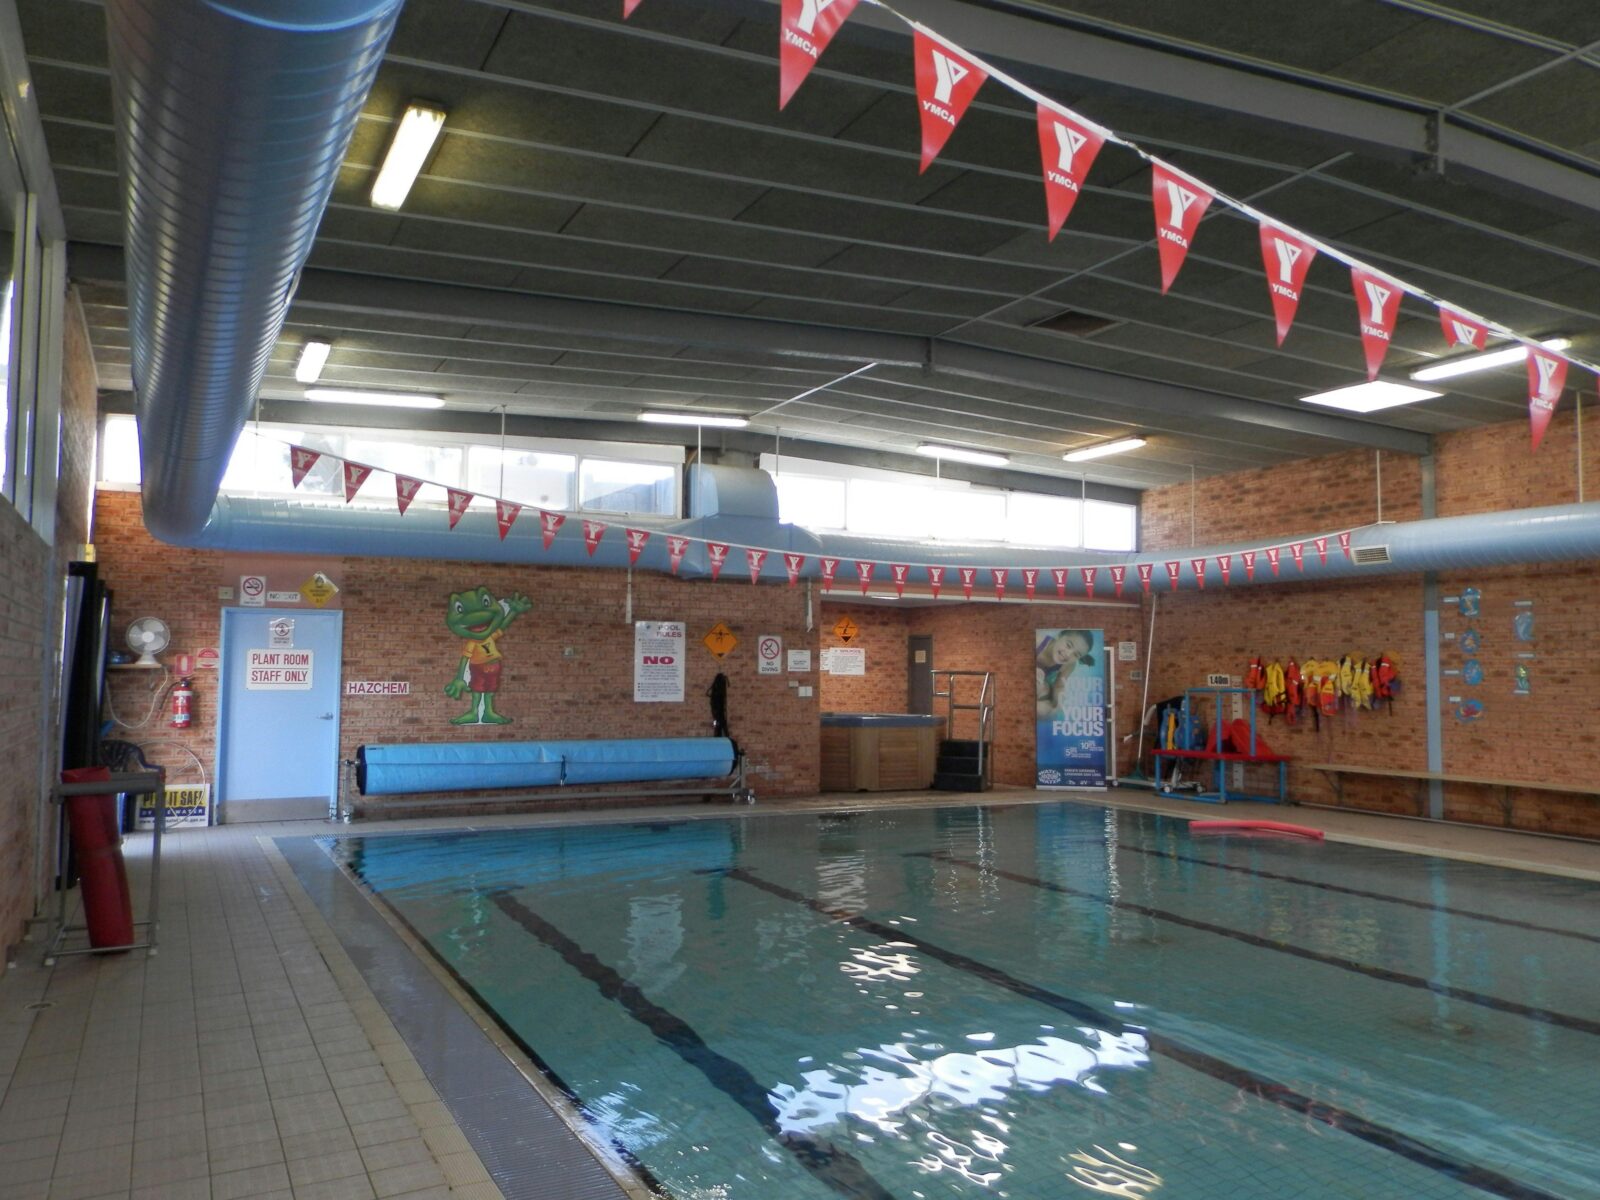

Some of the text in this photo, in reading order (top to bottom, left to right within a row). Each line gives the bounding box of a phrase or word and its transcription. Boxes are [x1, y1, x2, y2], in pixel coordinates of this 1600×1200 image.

[784, 29, 818, 59] YMCA
[932, 49, 969, 103] Y
[922, 100, 956, 125] YMCA
[1054, 121, 1087, 173] Y
[1047, 171, 1078, 193] YMCA
[1167, 180, 1197, 229] Y
[1160, 227, 1188, 248] YMCA
[1274, 237, 1302, 284] Y
[1272, 283, 1298, 302] YMCA
[1364, 280, 1391, 324] Y
[1361, 324, 1390, 341] YMCA
[1534, 354, 1558, 395] Y
[1530, 396, 1553, 411] YMCA
[297, 451, 312, 468] Y
[350, 466, 364, 483] Y
[401, 479, 414, 497] Y
[453, 493, 466, 510] Y
[501, 504, 514, 521] Y
[545, 514, 558, 530] Y
[588, 523, 601, 539] Y
[631, 531, 644, 547] Y
[672, 539, 684, 554] Y
[712, 545, 724, 560] Y
[751, 551, 762, 565] Y
[1245, 553, 1253, 565] Y
[1269, 549, 1277, 561] Y
[789, 556, 800, 570] Y
[825, 560, 835, 574] Y
[861, 563, 871, 577] Y
[1168, 563, 1177, 576] Y
[1195, 561, 1203, 572] Y
[1220, 557, 1228, 569] Y
[895, 566, 905, 580] Y
[931, 568, 941, 582] Y
[963, 570, 973, 583] Y
[995, 571, 1005, 583] Y
[1026, 571, 1035, 584] Y
[1055, 571, 1065, 583] Y
[1085, 569, 1093, 582] Y
[1114, 568, 1122, 580] Y
[1141, 566, 1150, 578] Y
[252, 653, 309, 665] PLANT ROOM
[643, 656, 674, 664] NO
[251, 670, 308, 681] STAFF ONLY
[1210, 676, 1228, 684] 1.40m
[349, 683, 408, 693] HAZCHEM
[1061, 676, 1103, 692] YOUR
[1057, 692, 1103, 706] CHILD
[1063, 706, 1103, 721] YOUR
[1052, 720, 1104, 736] FOCUS
[169, 791, 179, 806] IT
